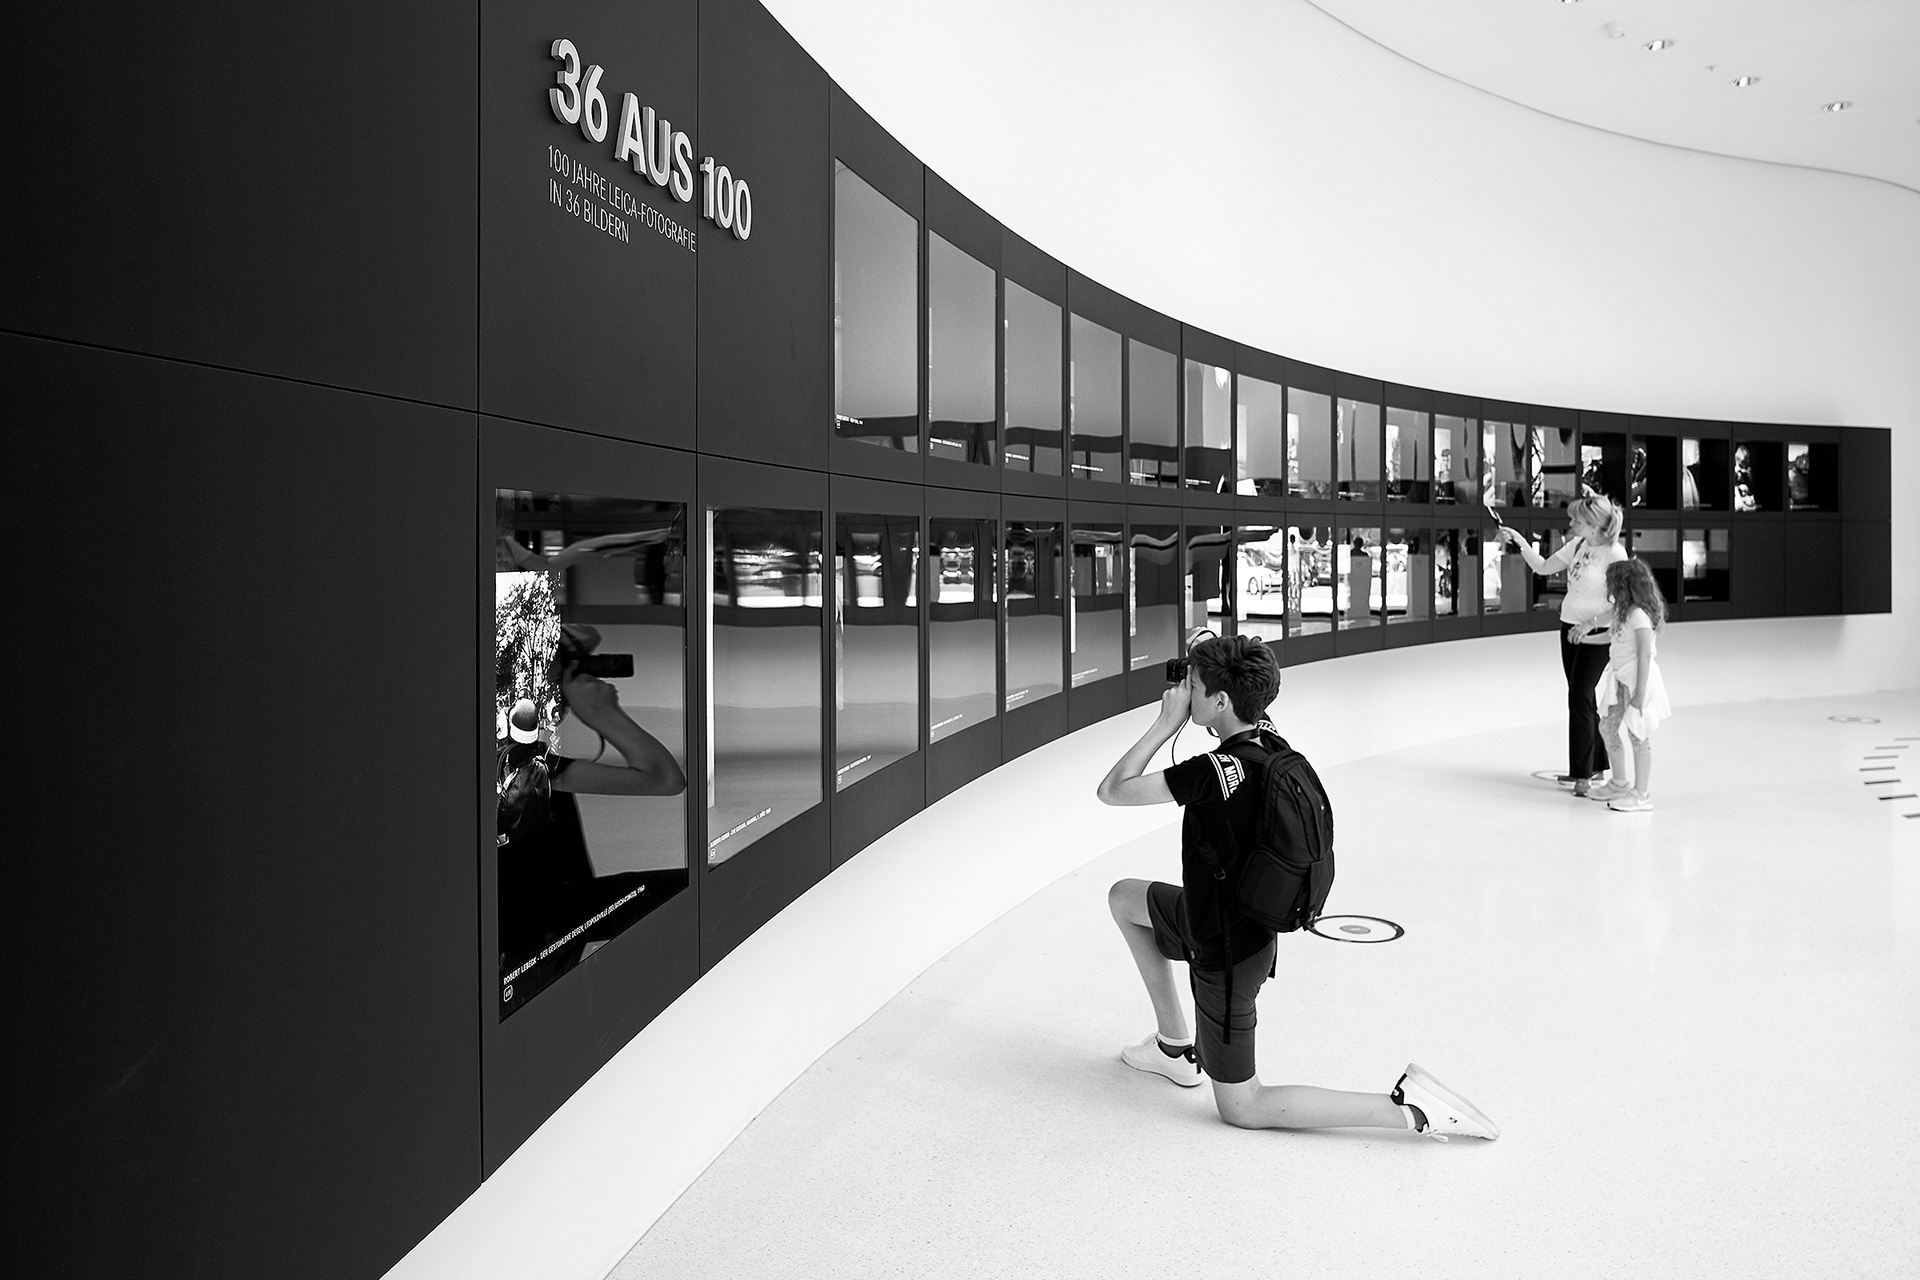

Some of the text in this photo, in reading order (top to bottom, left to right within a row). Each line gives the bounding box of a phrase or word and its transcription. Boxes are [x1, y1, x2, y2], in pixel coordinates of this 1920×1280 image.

[549, 38, 752, 241] 36 AUS 100
[548, 144, 696, 253] 100 JAHRE LEICA-FOTOGRAFIE
[549, 178, 630, 244] IN 36 BILDERN
[503, 967, 521, 986] ROBERT
[520, 956, 537, 974] LEBECK
